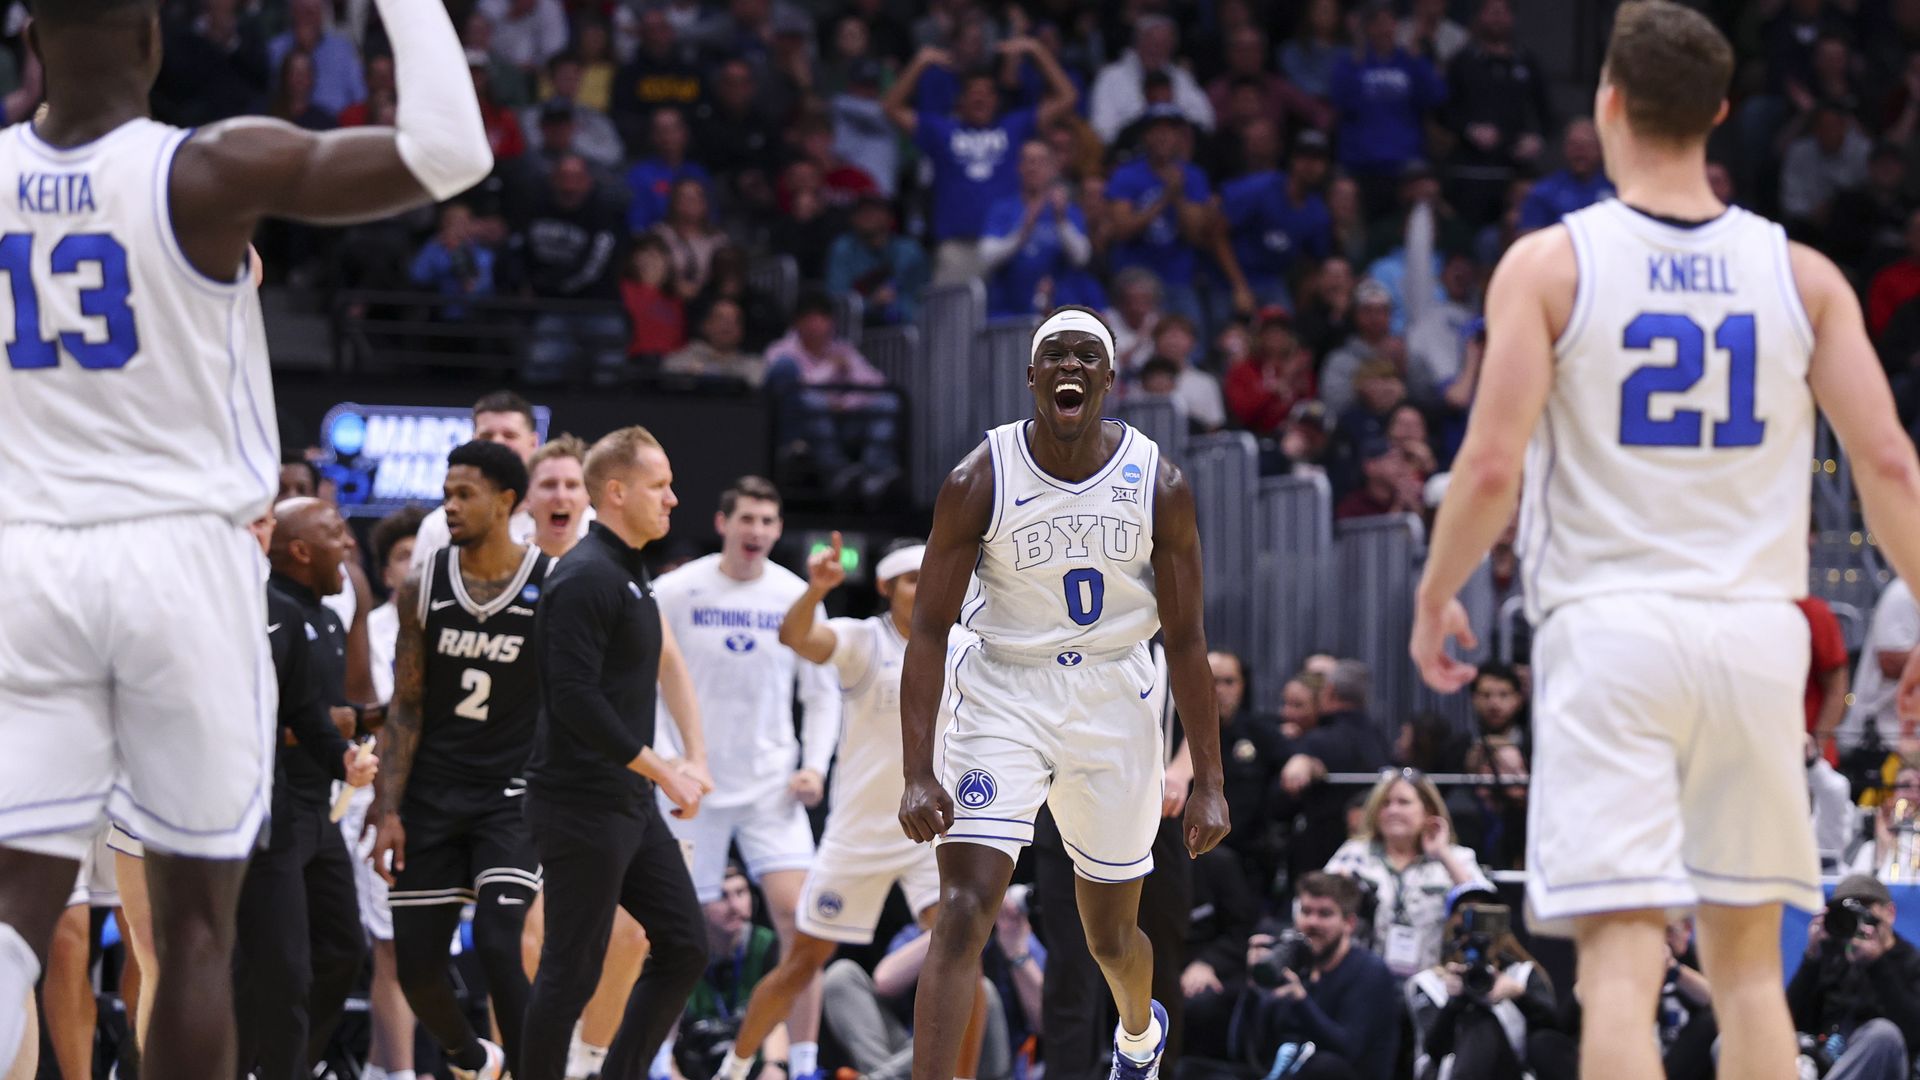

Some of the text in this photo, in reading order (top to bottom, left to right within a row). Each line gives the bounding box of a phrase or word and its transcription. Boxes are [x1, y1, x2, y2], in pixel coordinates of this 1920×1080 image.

[18, 171, 96, 214] KEITA
[0, 232, 141, 371] 13
[1648, 254, 1736, 296] KNELL
[1618, 312, 1767, 449] 21
[1012, 514, 1141, 571] BYU
[692, 606, 752, 629] NOTHING
[1062, 567, 1105, 626] 0
[437, 626, 525, 664] RAMS
[454, 667, 491, 721] 2
